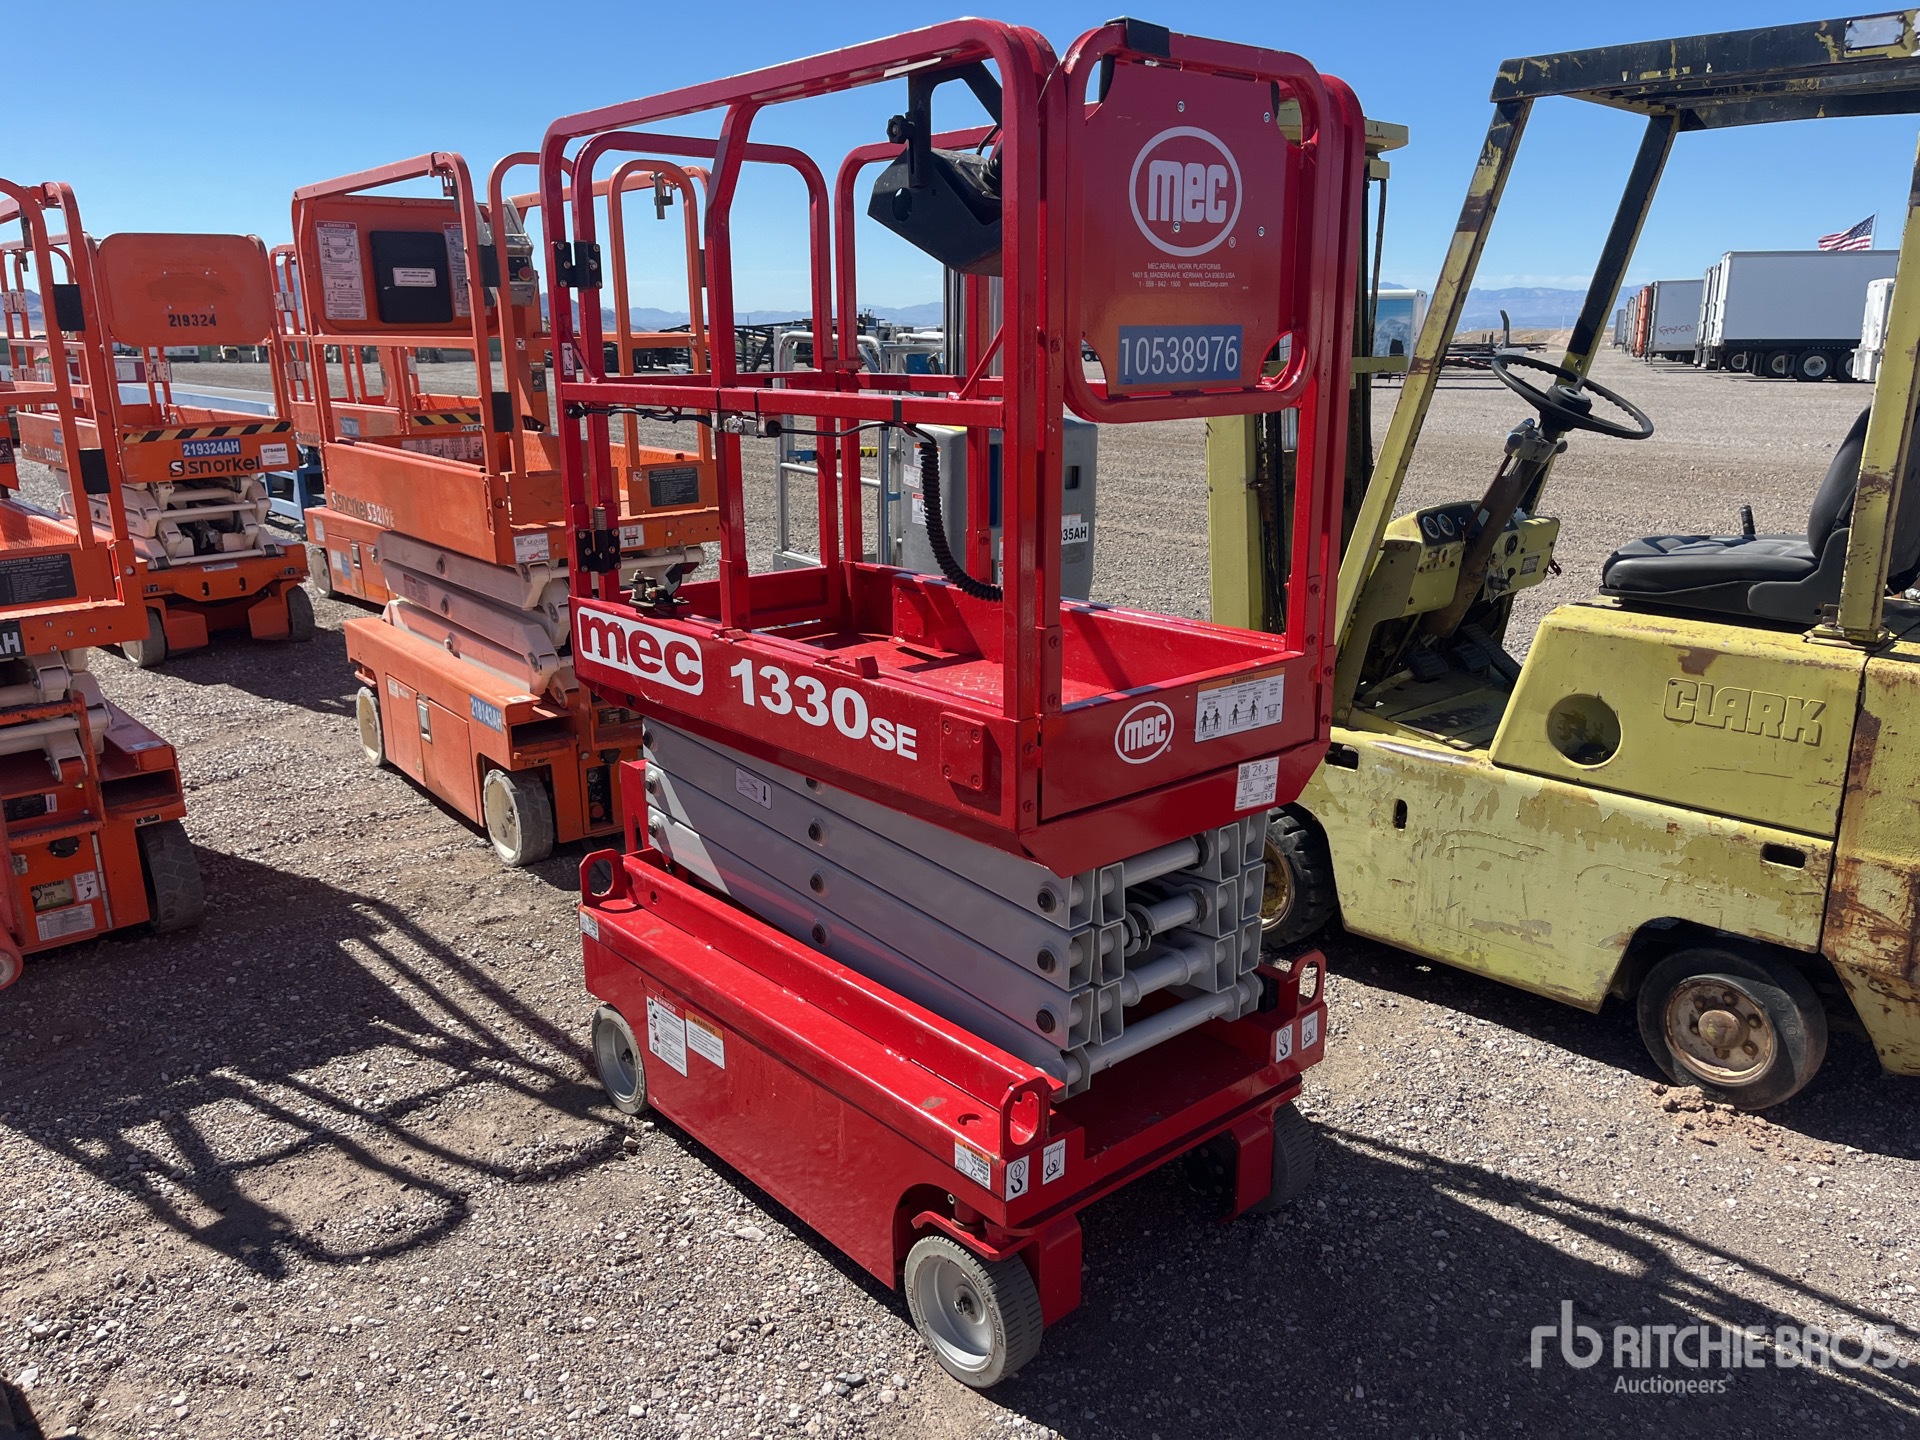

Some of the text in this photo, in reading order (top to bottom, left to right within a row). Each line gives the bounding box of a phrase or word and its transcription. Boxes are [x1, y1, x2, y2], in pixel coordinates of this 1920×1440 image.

[168, 313, 217, 327] 219324
[1121, 335, 1239, 376] 10538976
[183, 440, 240, 457] 219324AH
[188, 455, 261, 475] snorkel
[1061, 526, 1087, 541] 35AH
[1663, 677, 1827, 747] CLARK
